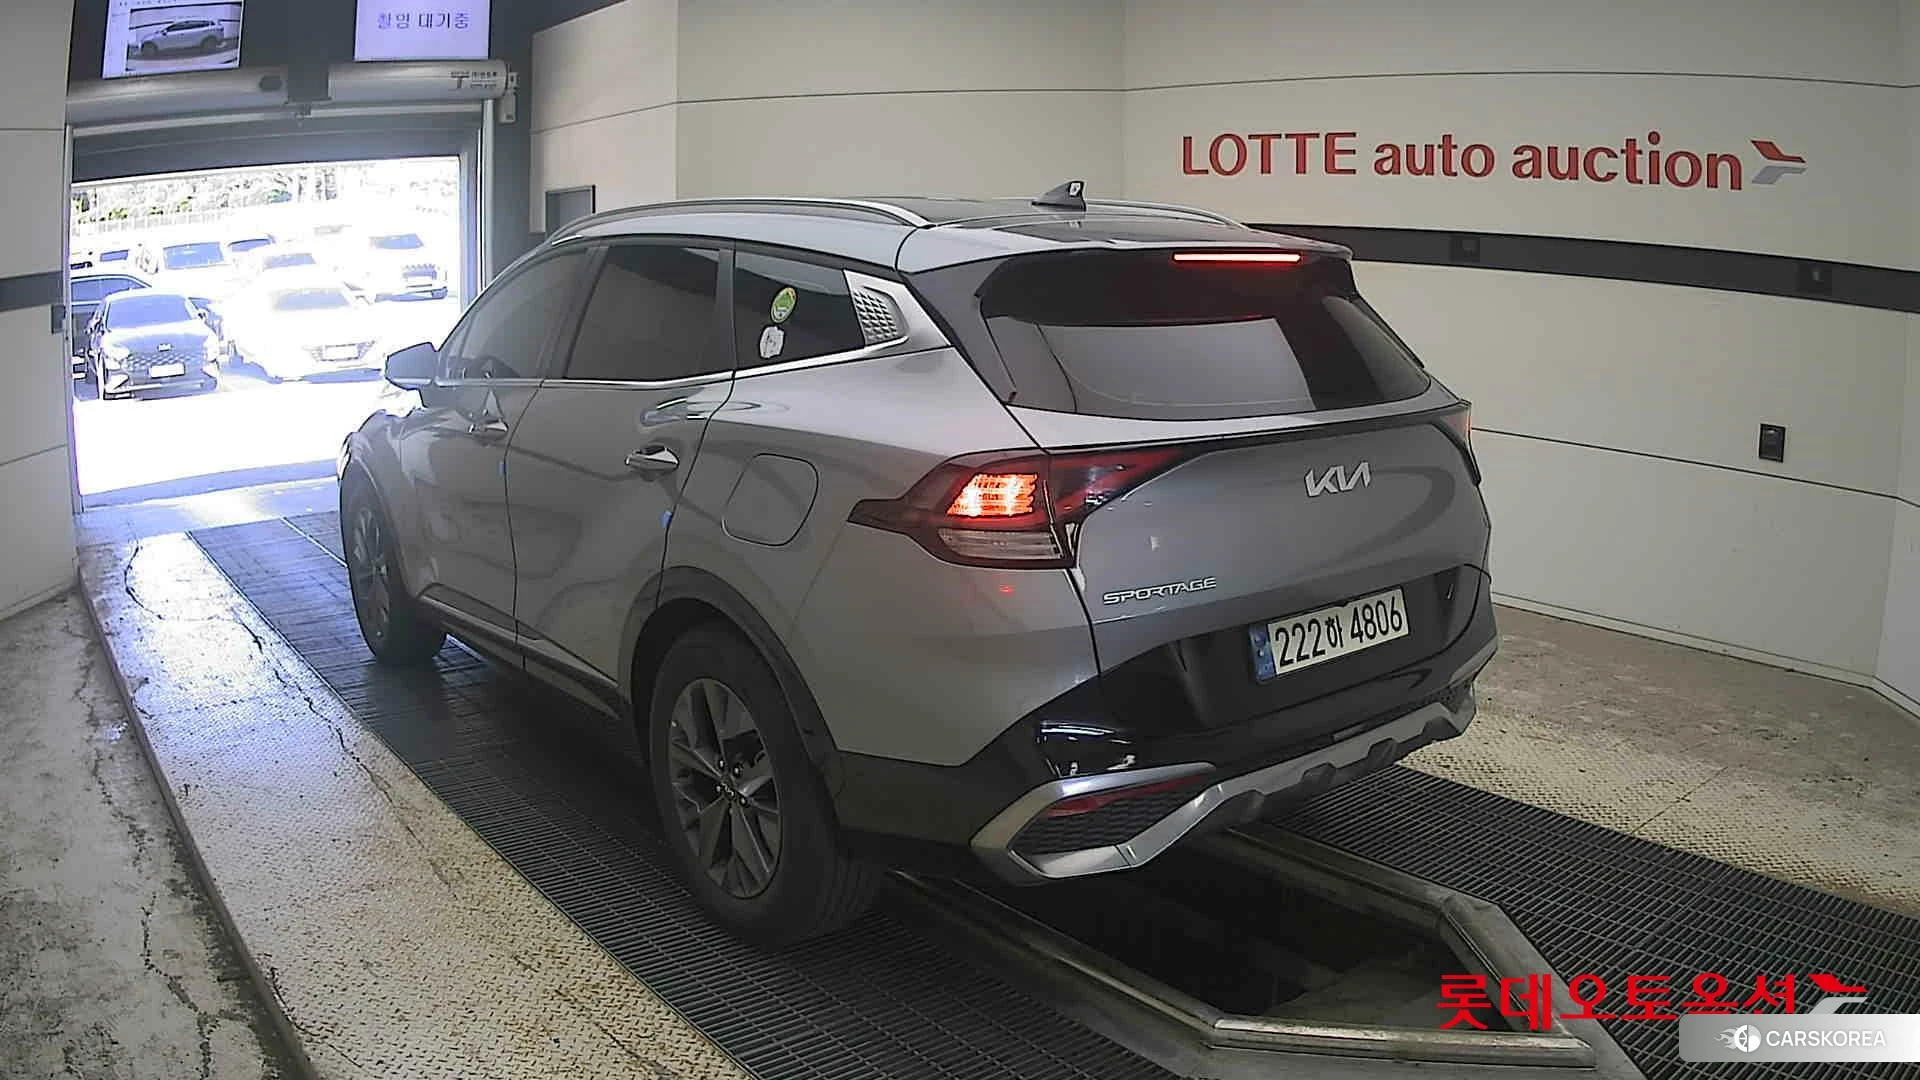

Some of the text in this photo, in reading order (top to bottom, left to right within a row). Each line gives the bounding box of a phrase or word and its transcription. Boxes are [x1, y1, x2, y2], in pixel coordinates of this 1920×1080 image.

[418, 12, 469, 29] 대기중
[1182, 131, 1742, 191] LOTTE auto auction
[1304, 461, 1371, 497] KIA
[1103, 576, 1217, 605] SPORTAGE
[1275, 596, 1403, 667] 222하 4806
